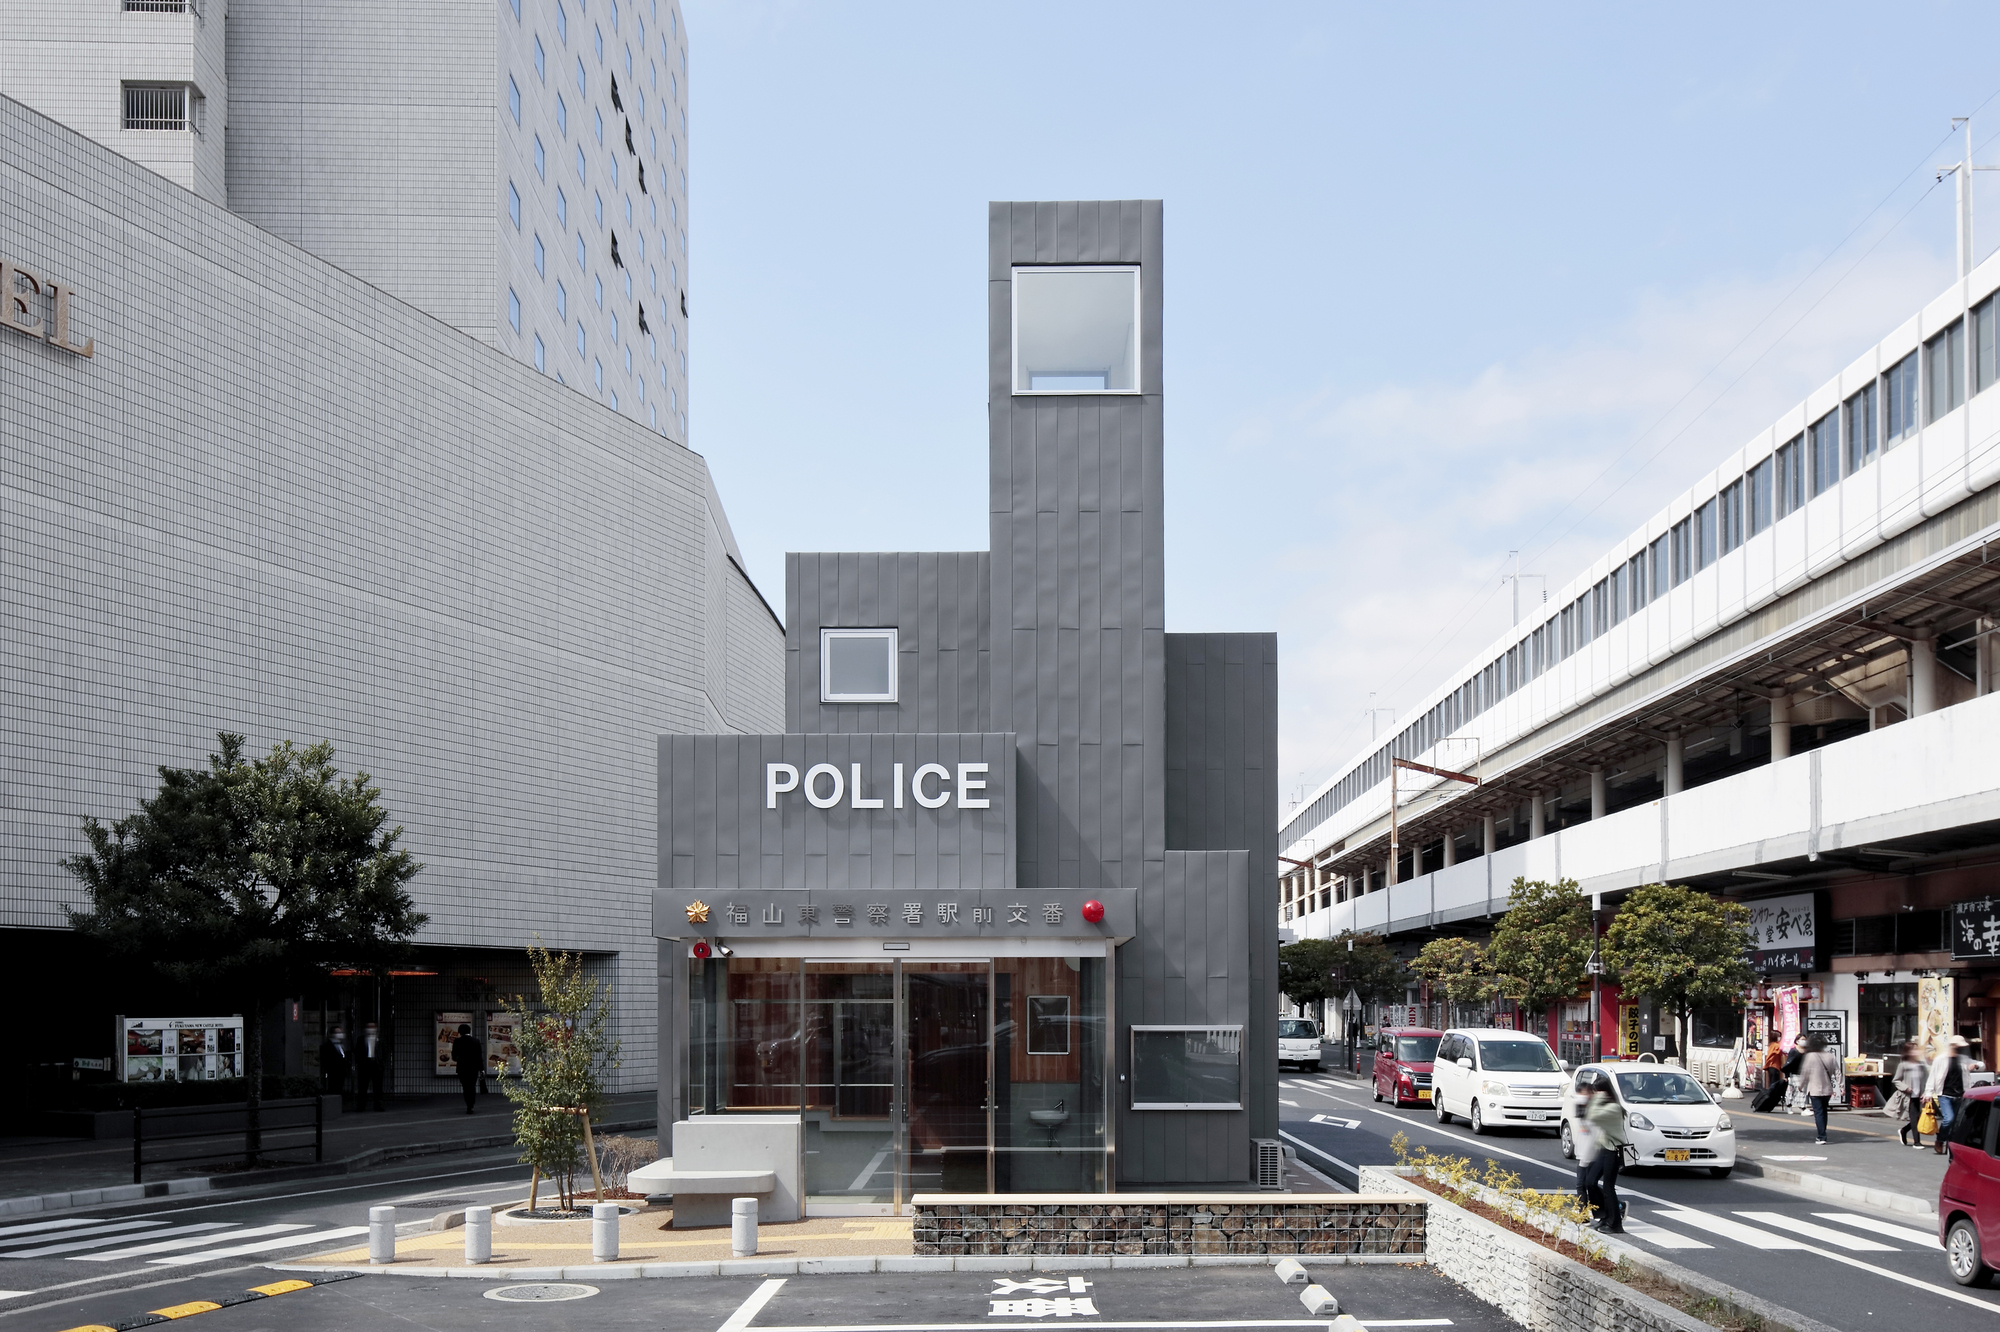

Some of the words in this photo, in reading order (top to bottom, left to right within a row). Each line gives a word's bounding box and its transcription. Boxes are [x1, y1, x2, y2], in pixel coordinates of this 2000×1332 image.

[766, 762, 990, 809] POLICE
[726, 901, 1064, 925] 福山東警察署駅前交番
[1768, 953, 1799, 968] ハイボール
[1628, 1007, 1639, 1052] 餃子の日
[1808, 1020, 1839, 1029] 大衆食堂
